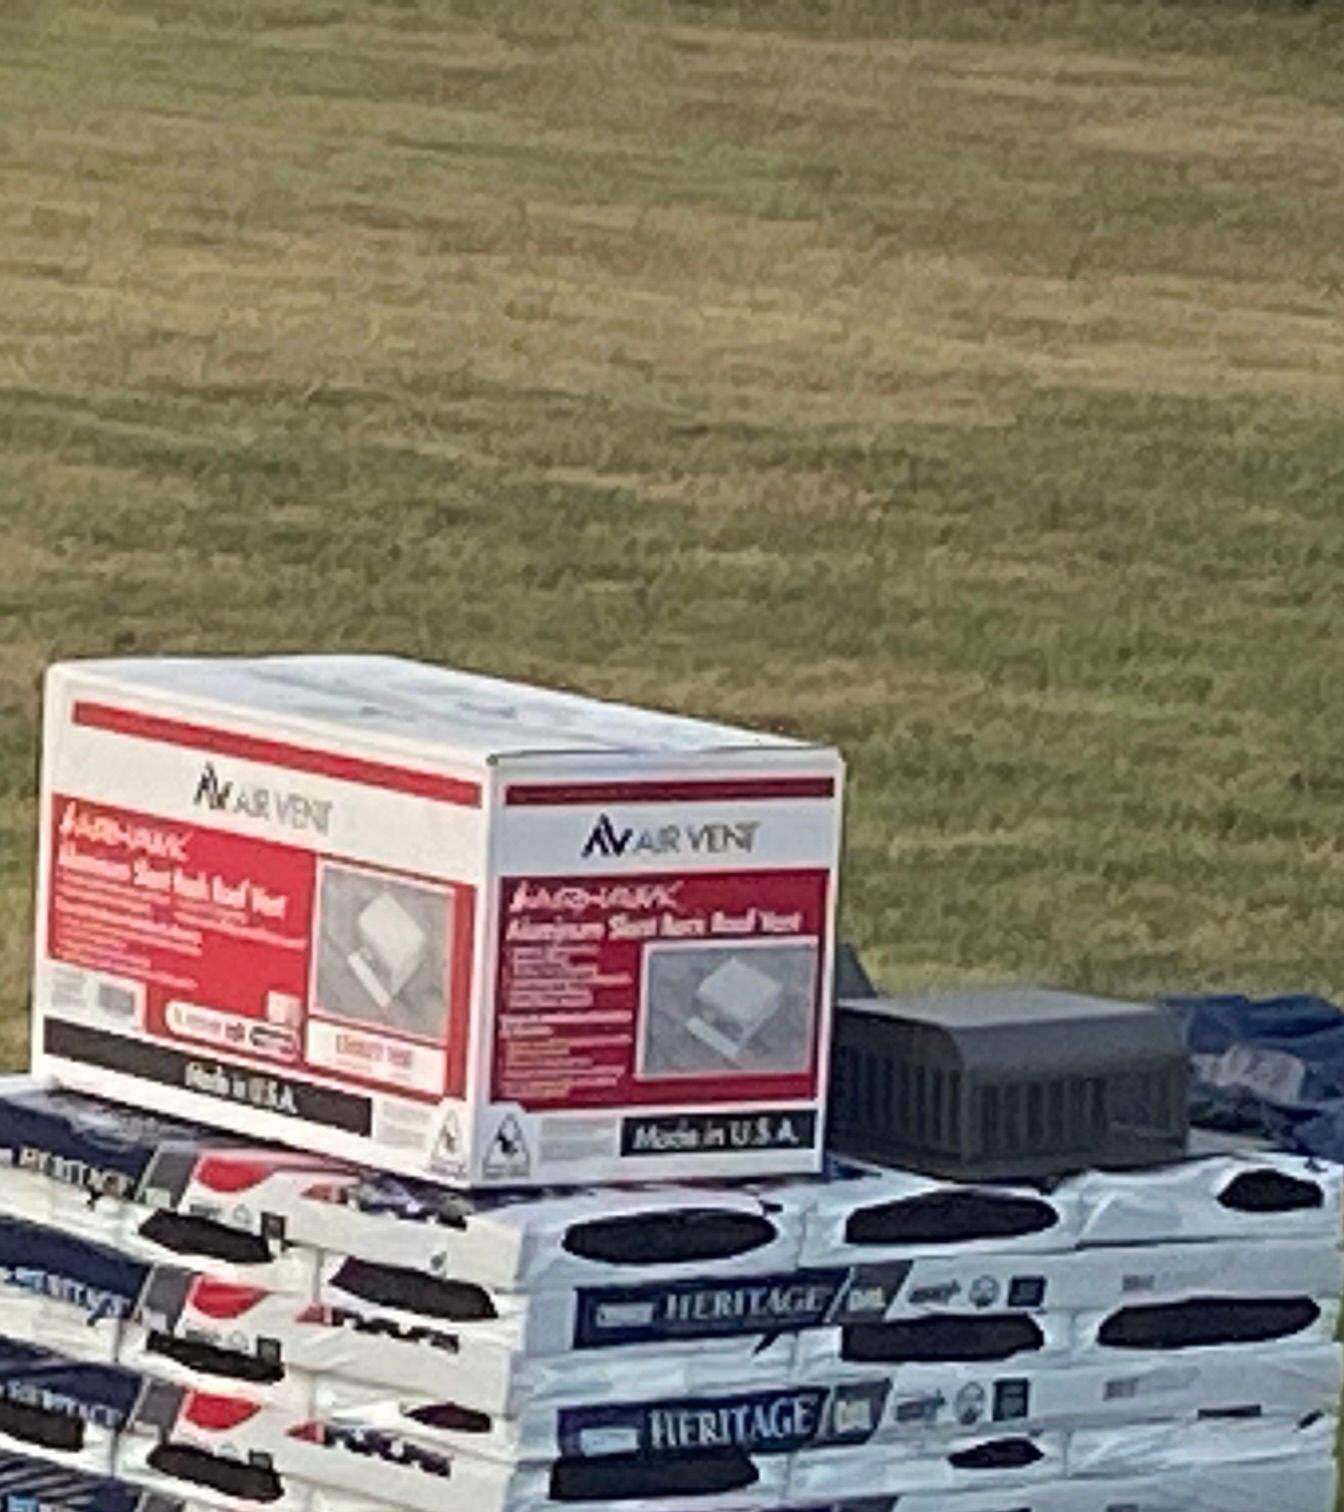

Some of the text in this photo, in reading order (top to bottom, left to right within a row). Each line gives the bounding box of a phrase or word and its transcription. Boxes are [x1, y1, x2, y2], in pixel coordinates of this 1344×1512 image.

[233, 786, 270, 821] AIR
[273, 790, 333, 836] VENT
[632, 824, 681, 853] AIR
[686, 819, 762, 854] VENT
[631, 1113, 698, 1150] Made
[703, 1120, 725, 1147] in
[662, 1284, 826, 1322] HERITAGE
[648, 1397, 818, 1449] HERITAGE
